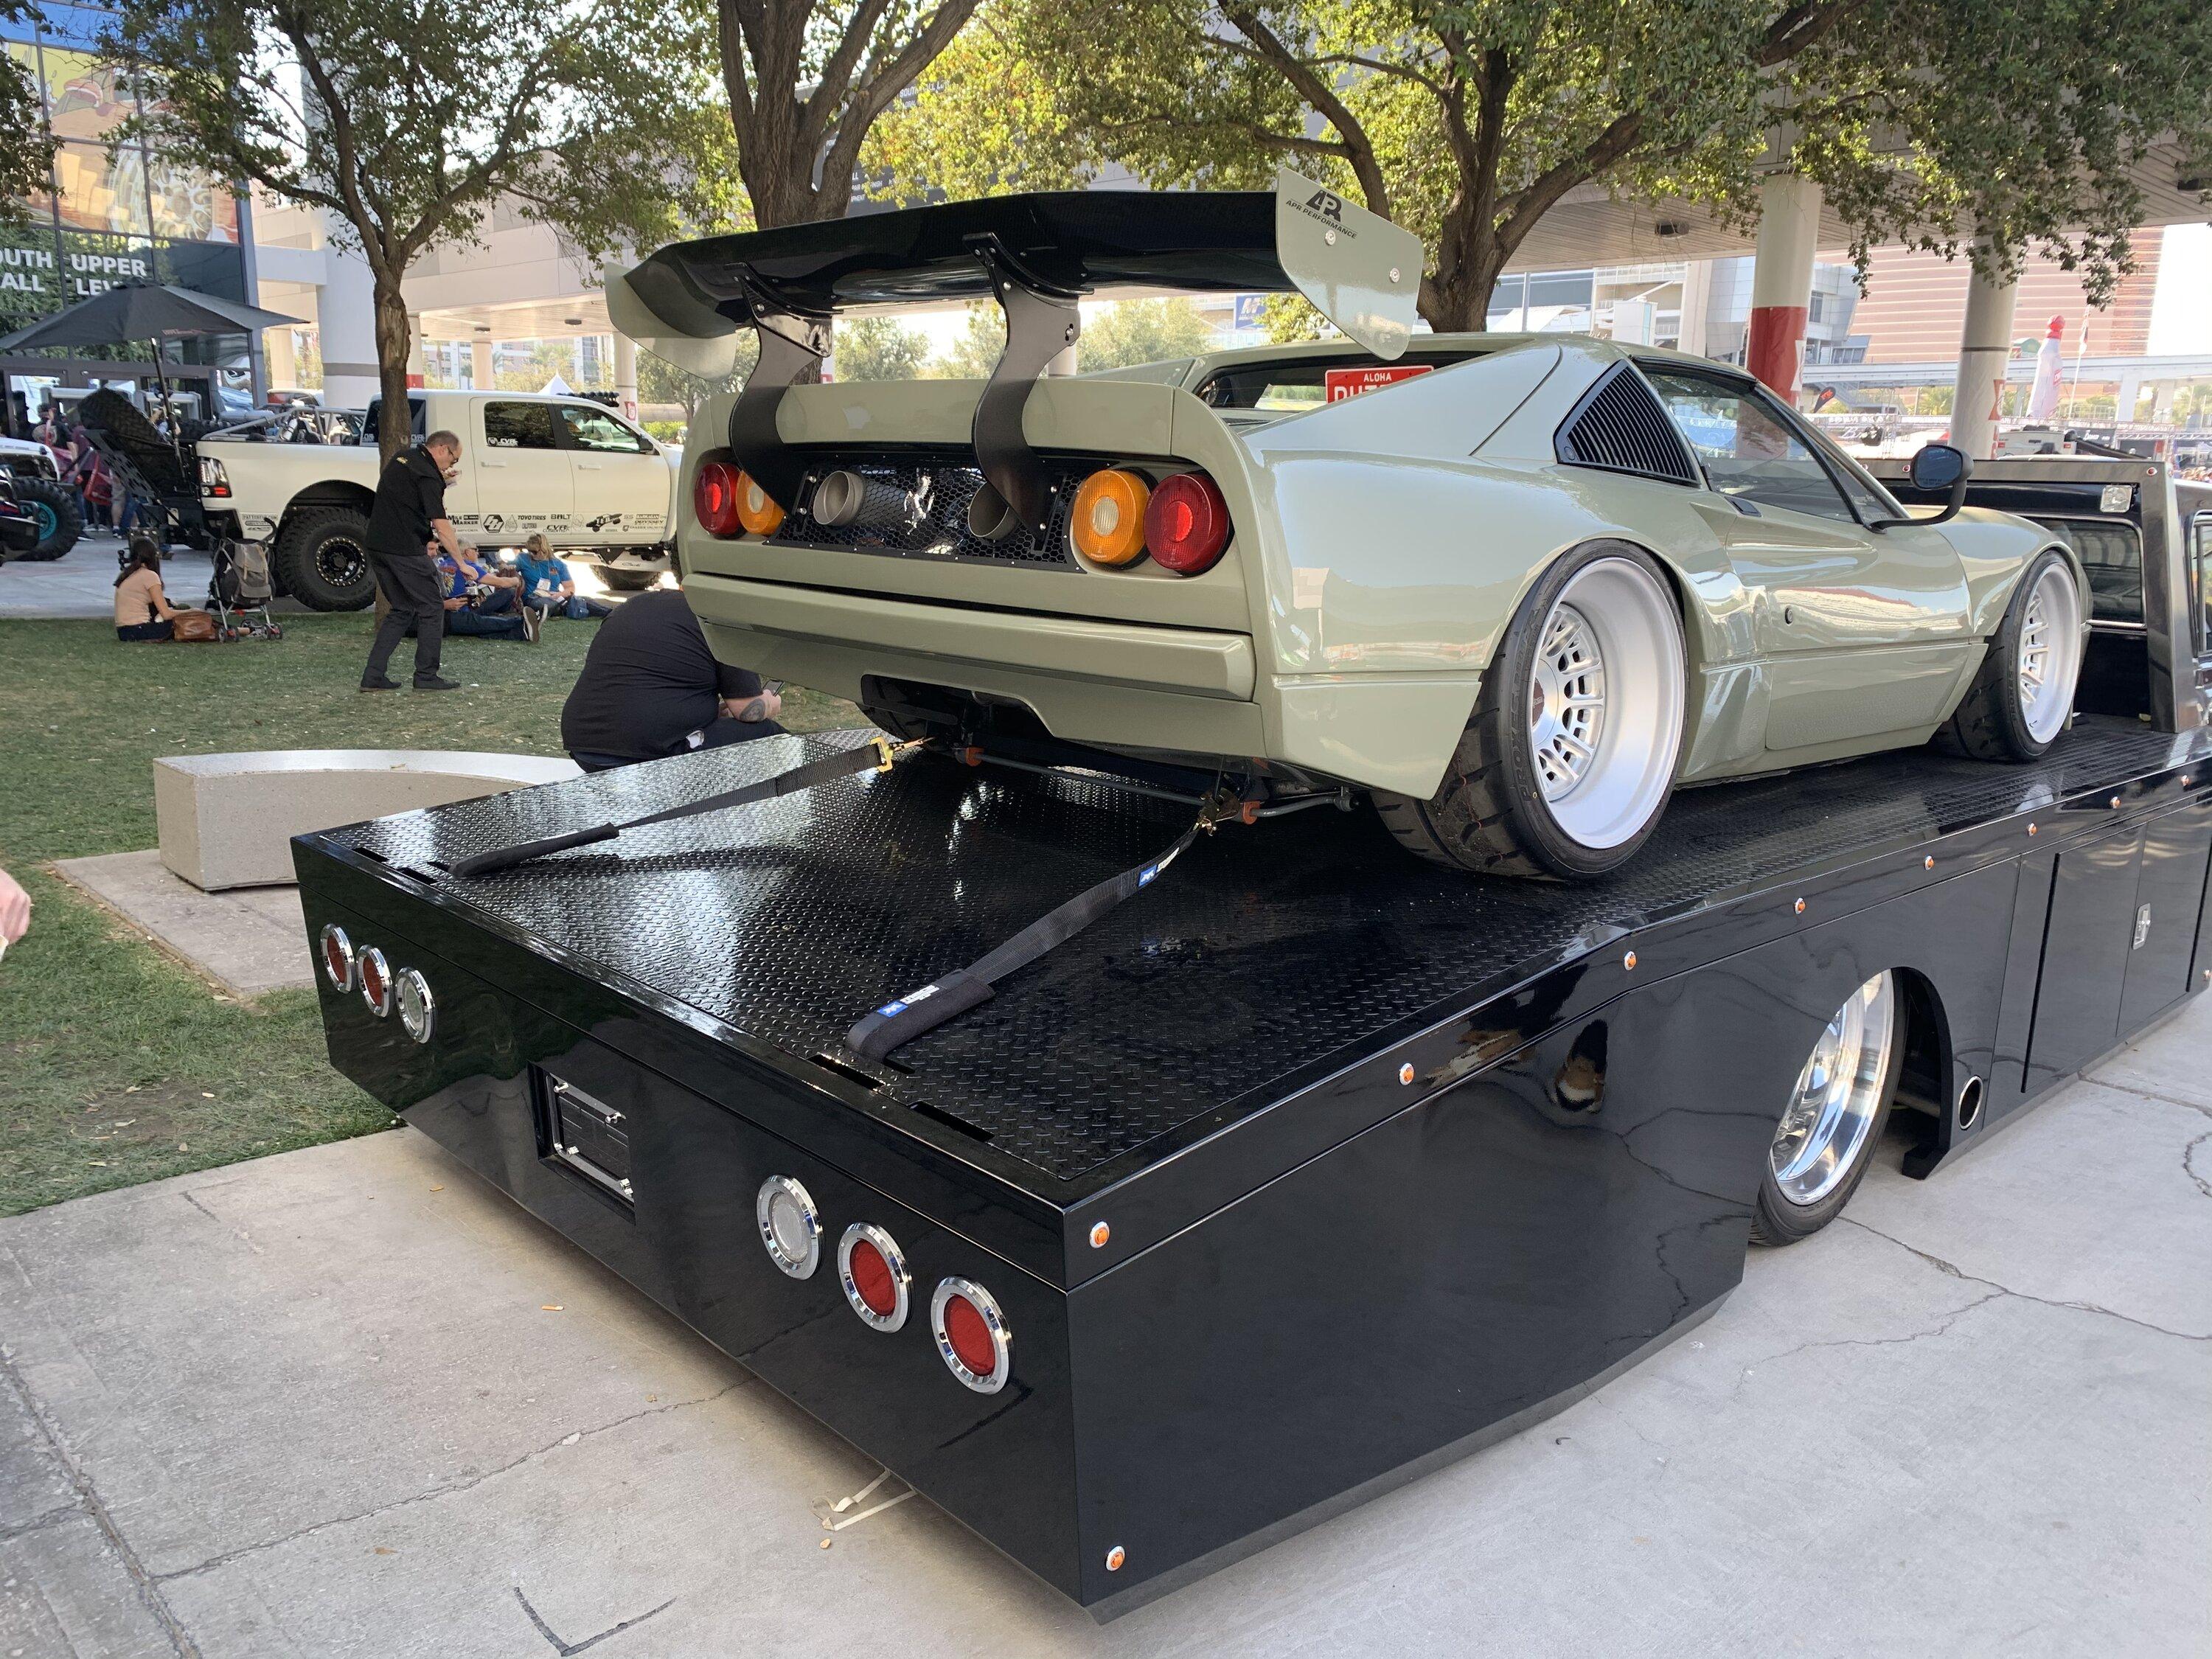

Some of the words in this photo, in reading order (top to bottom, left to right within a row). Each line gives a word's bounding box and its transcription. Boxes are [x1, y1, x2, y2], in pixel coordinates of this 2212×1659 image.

[1285, 199, 1302, 212] APR
[1302, 208, 1357, 240] PERFORMANCE
[70, 253, 147, 277] UPPER
[75, 277, 124, 296] LEV
[1363, 372, 1392, 383] ALOHA
